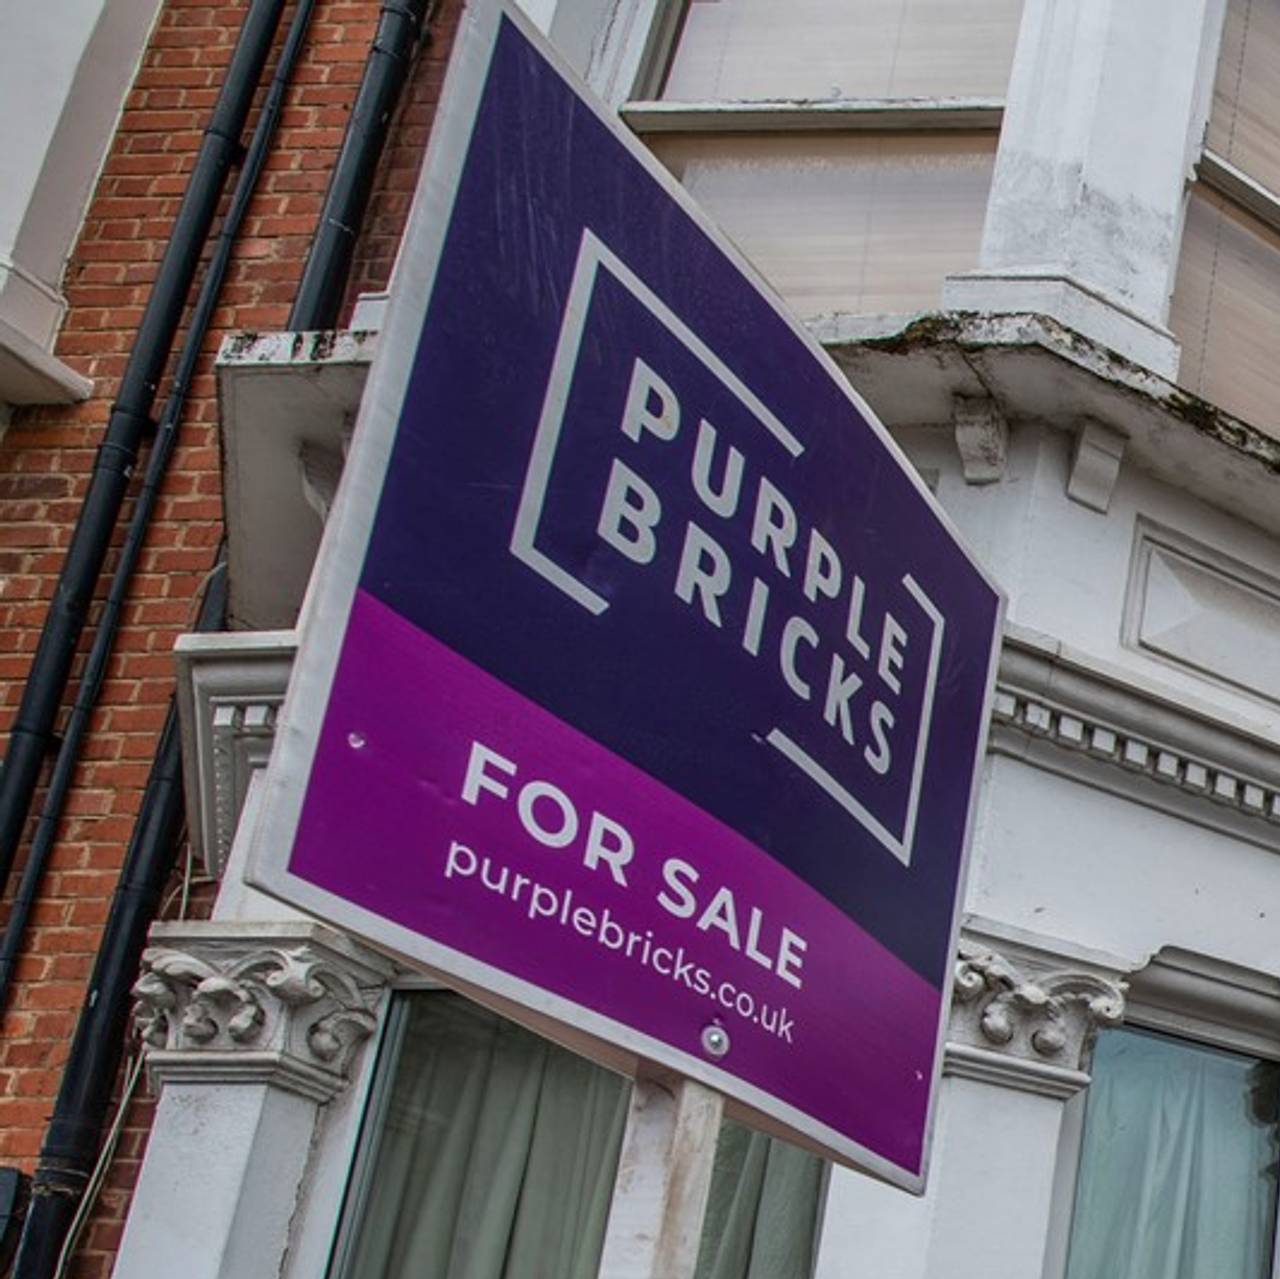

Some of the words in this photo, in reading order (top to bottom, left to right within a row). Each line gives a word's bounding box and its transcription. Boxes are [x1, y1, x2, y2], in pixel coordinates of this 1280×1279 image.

[598, 458, 894, 774] BRICKS
[621, 357, 907, 695] PURPLE
[445, 840, 793, 1043] purplebricks.co.uk
[461, 740, 635, 888] FOR
[656, 858, 807, 989] SALE
